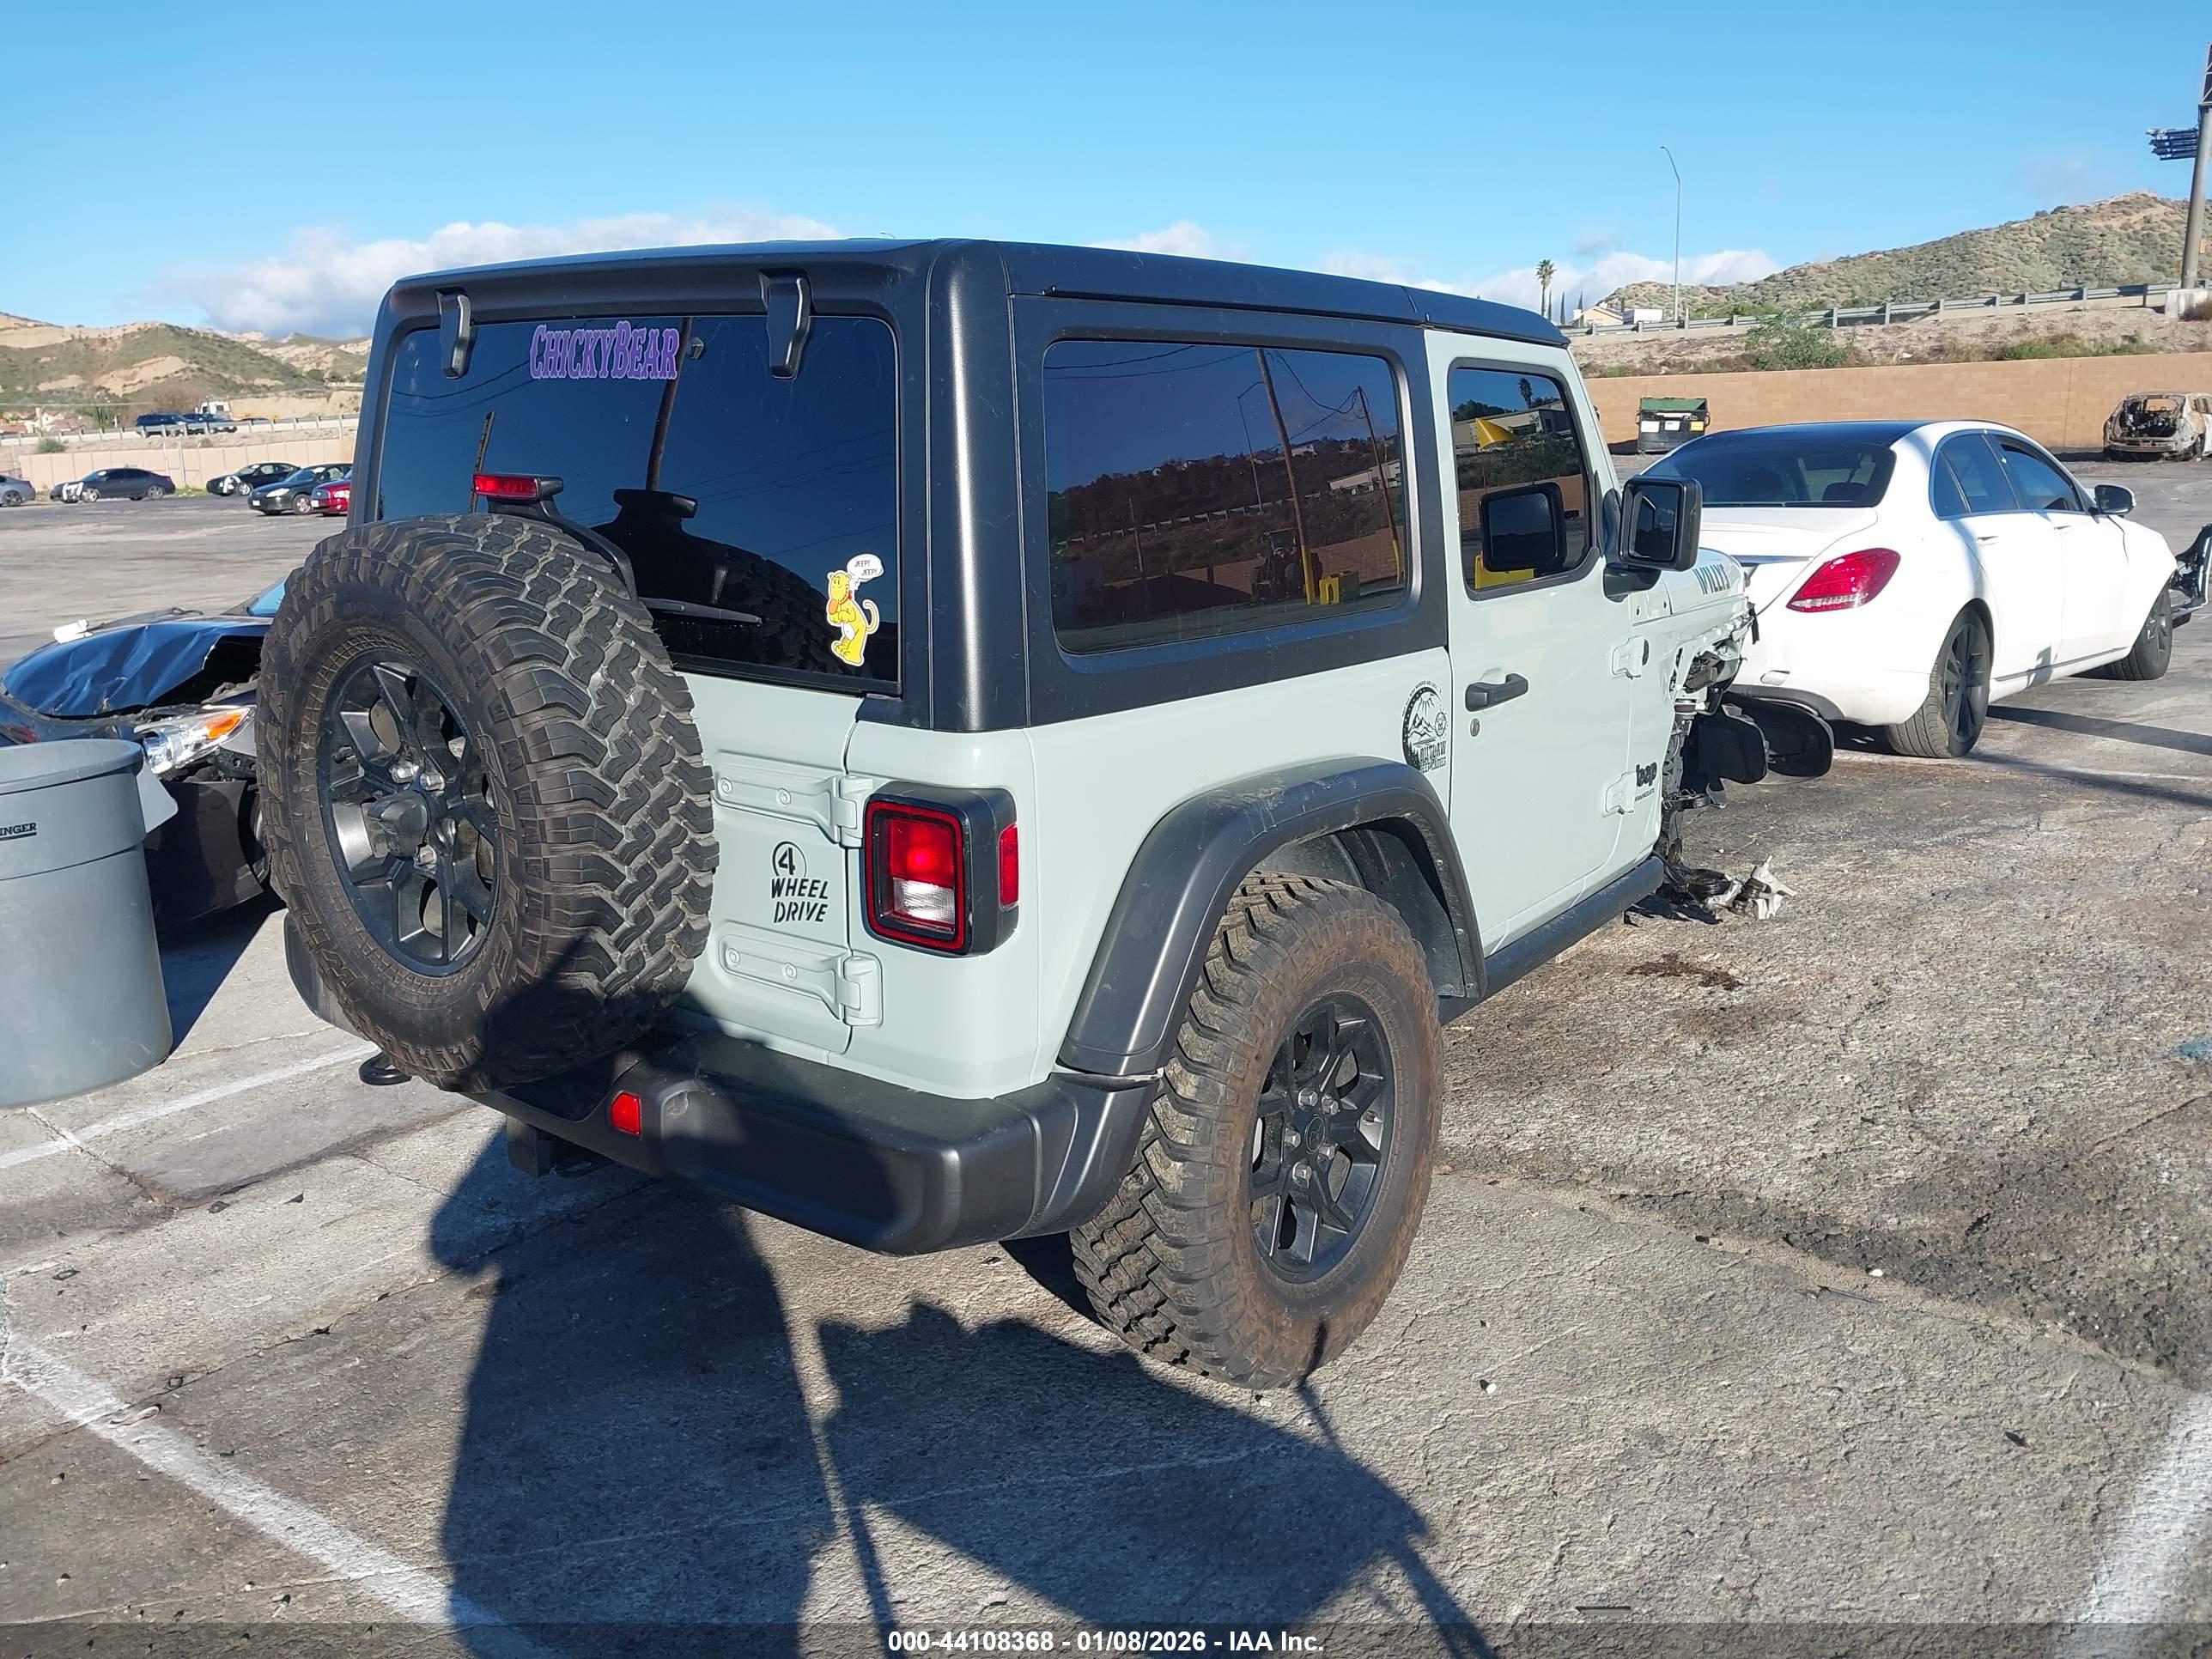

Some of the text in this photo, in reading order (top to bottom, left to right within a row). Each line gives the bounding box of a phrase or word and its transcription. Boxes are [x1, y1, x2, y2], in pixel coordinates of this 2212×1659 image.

[1692, 563, 1729, 595] WILLYS
[1419, 740, 1446, 763] OUTLAW
[477, 720, 517, 1011] FALKEN
[778, 847, 795, 875] 4
[771, 878, 828, 899] WHEEL
[774, 901, 828, 923] DRIVE
